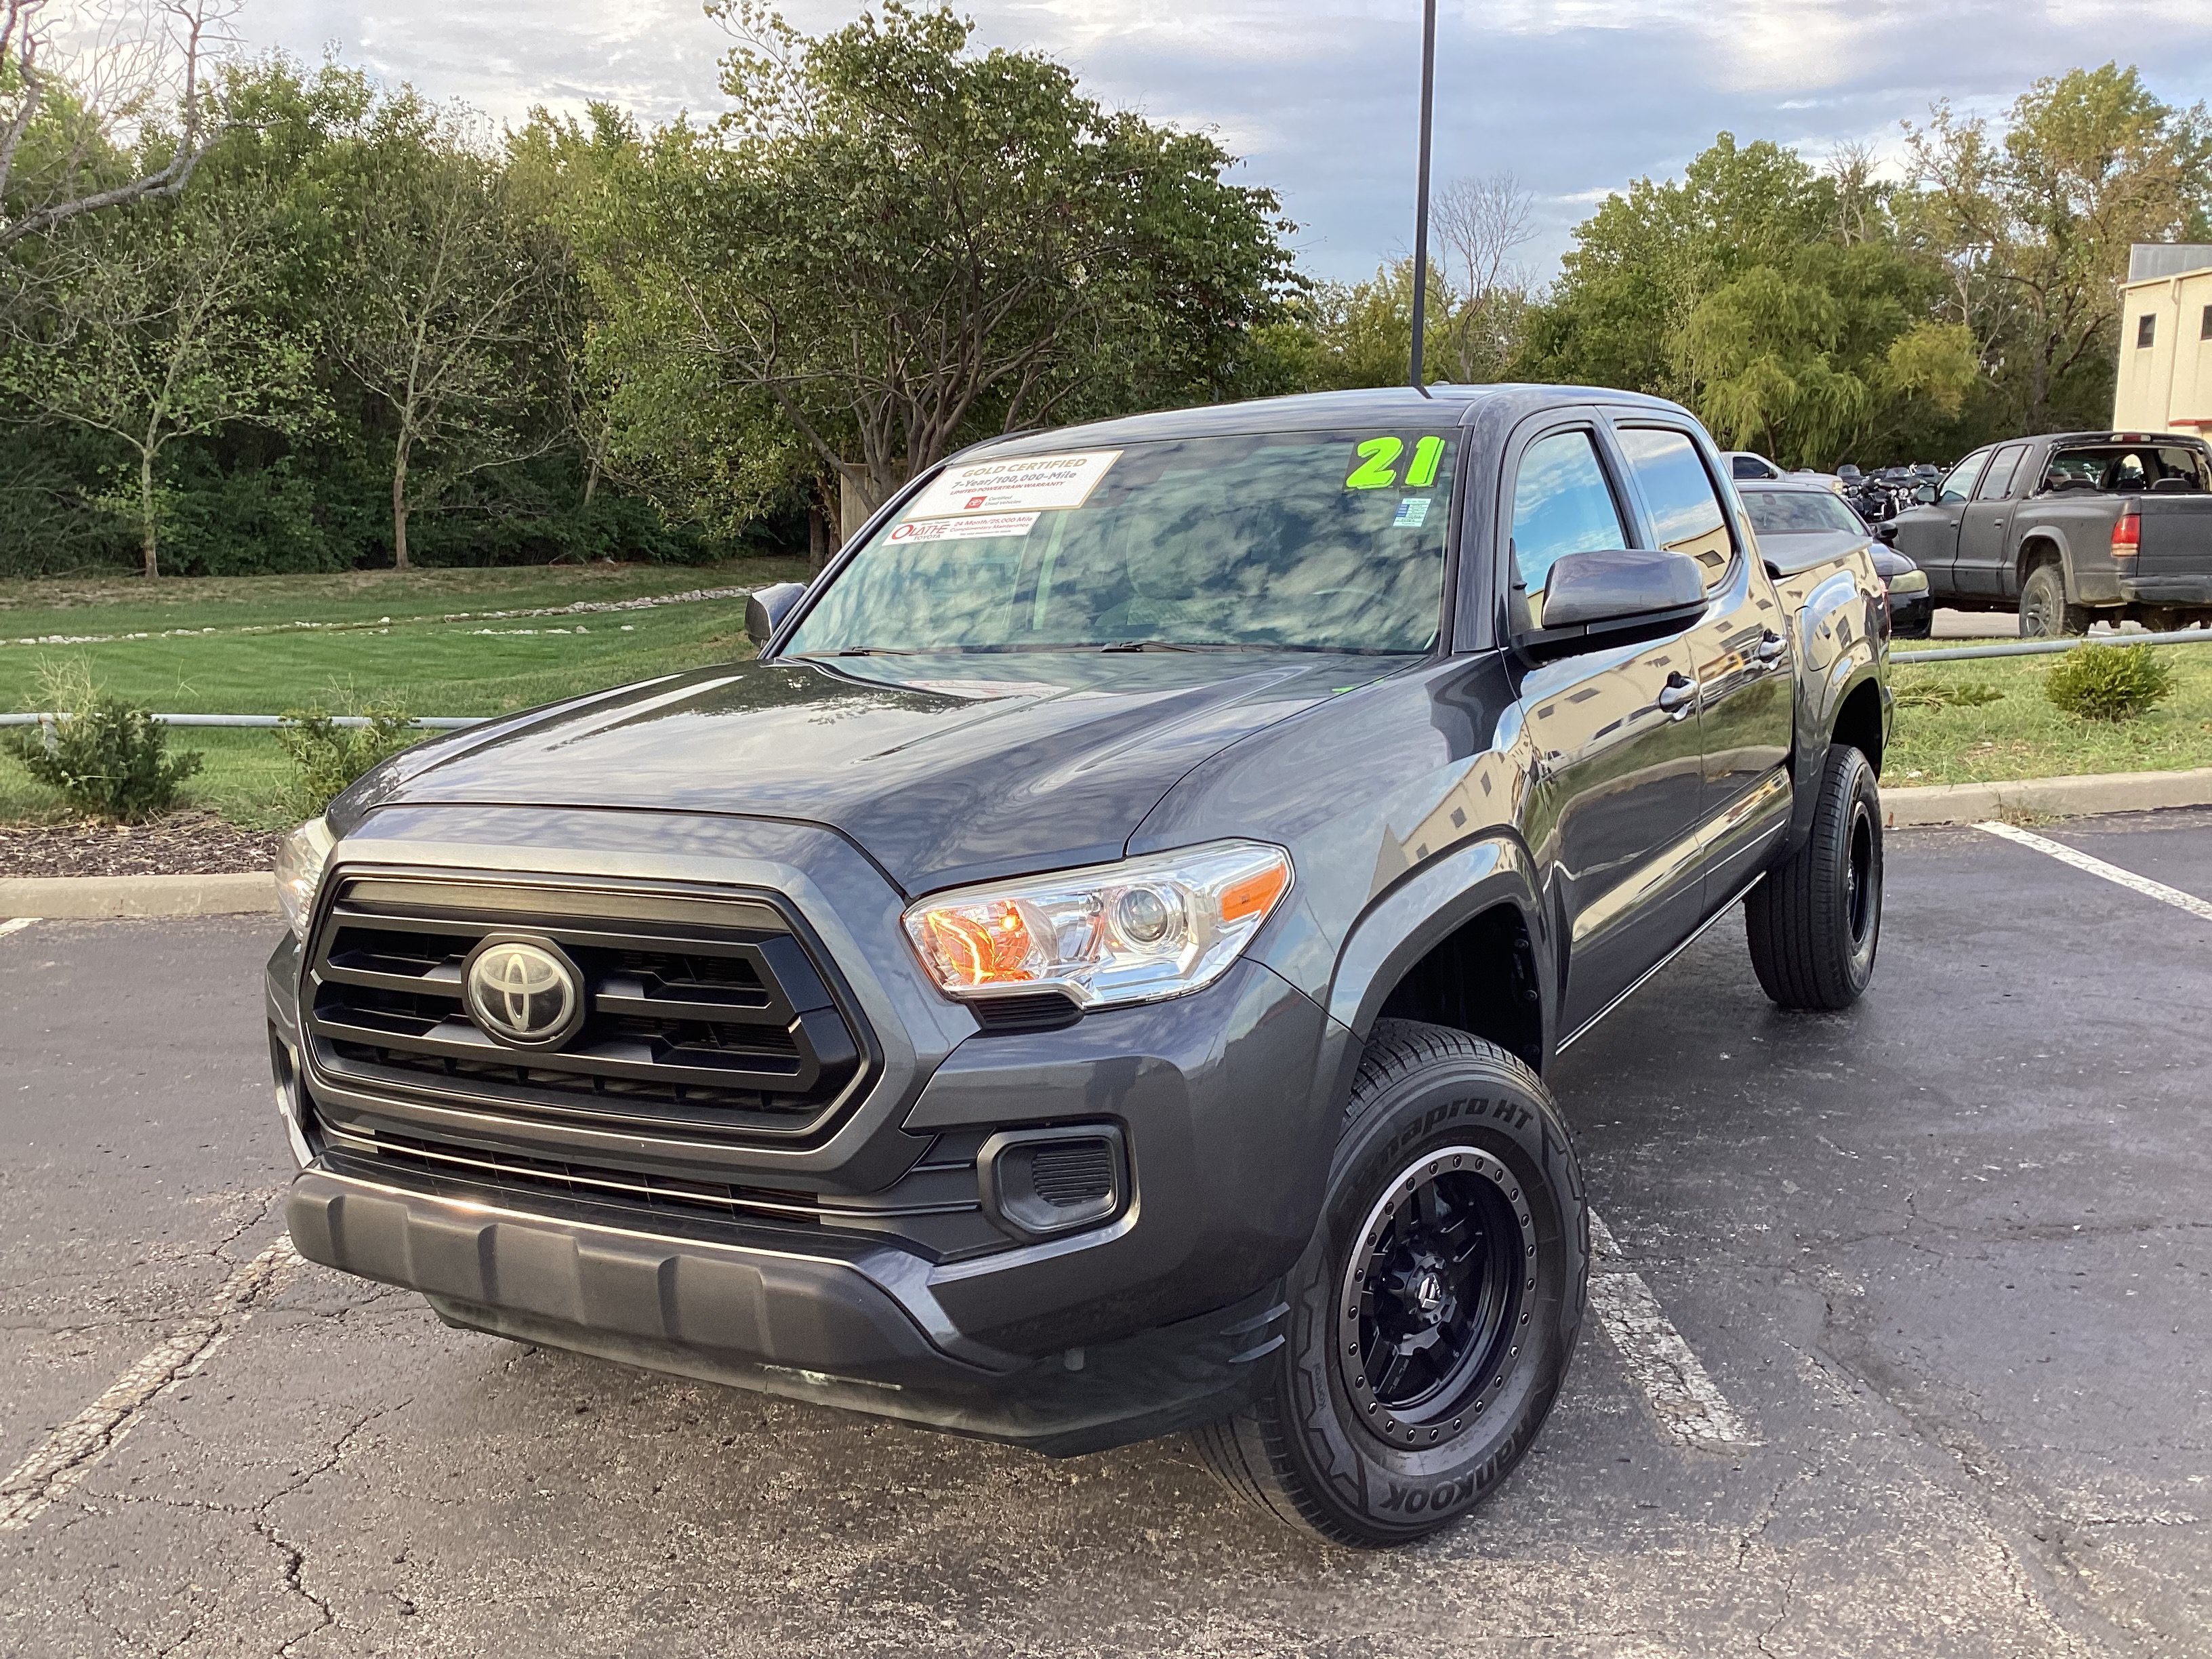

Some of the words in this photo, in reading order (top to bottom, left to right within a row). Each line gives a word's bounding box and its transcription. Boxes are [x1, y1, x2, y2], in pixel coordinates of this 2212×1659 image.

[962, 466, 1006, 478] GOLD
[1007, 458, 1088, 472] CERTIFIED
[1346, 436, 1446, 489] 21
[951, 470, 1077, 489] 7-Year/100,000-Mile
[977, 484, 1023, 492] POWERTRAIN
[891, 524, 950, 540] OLATHE
[1492, 1099, 1534, 1130] HT
